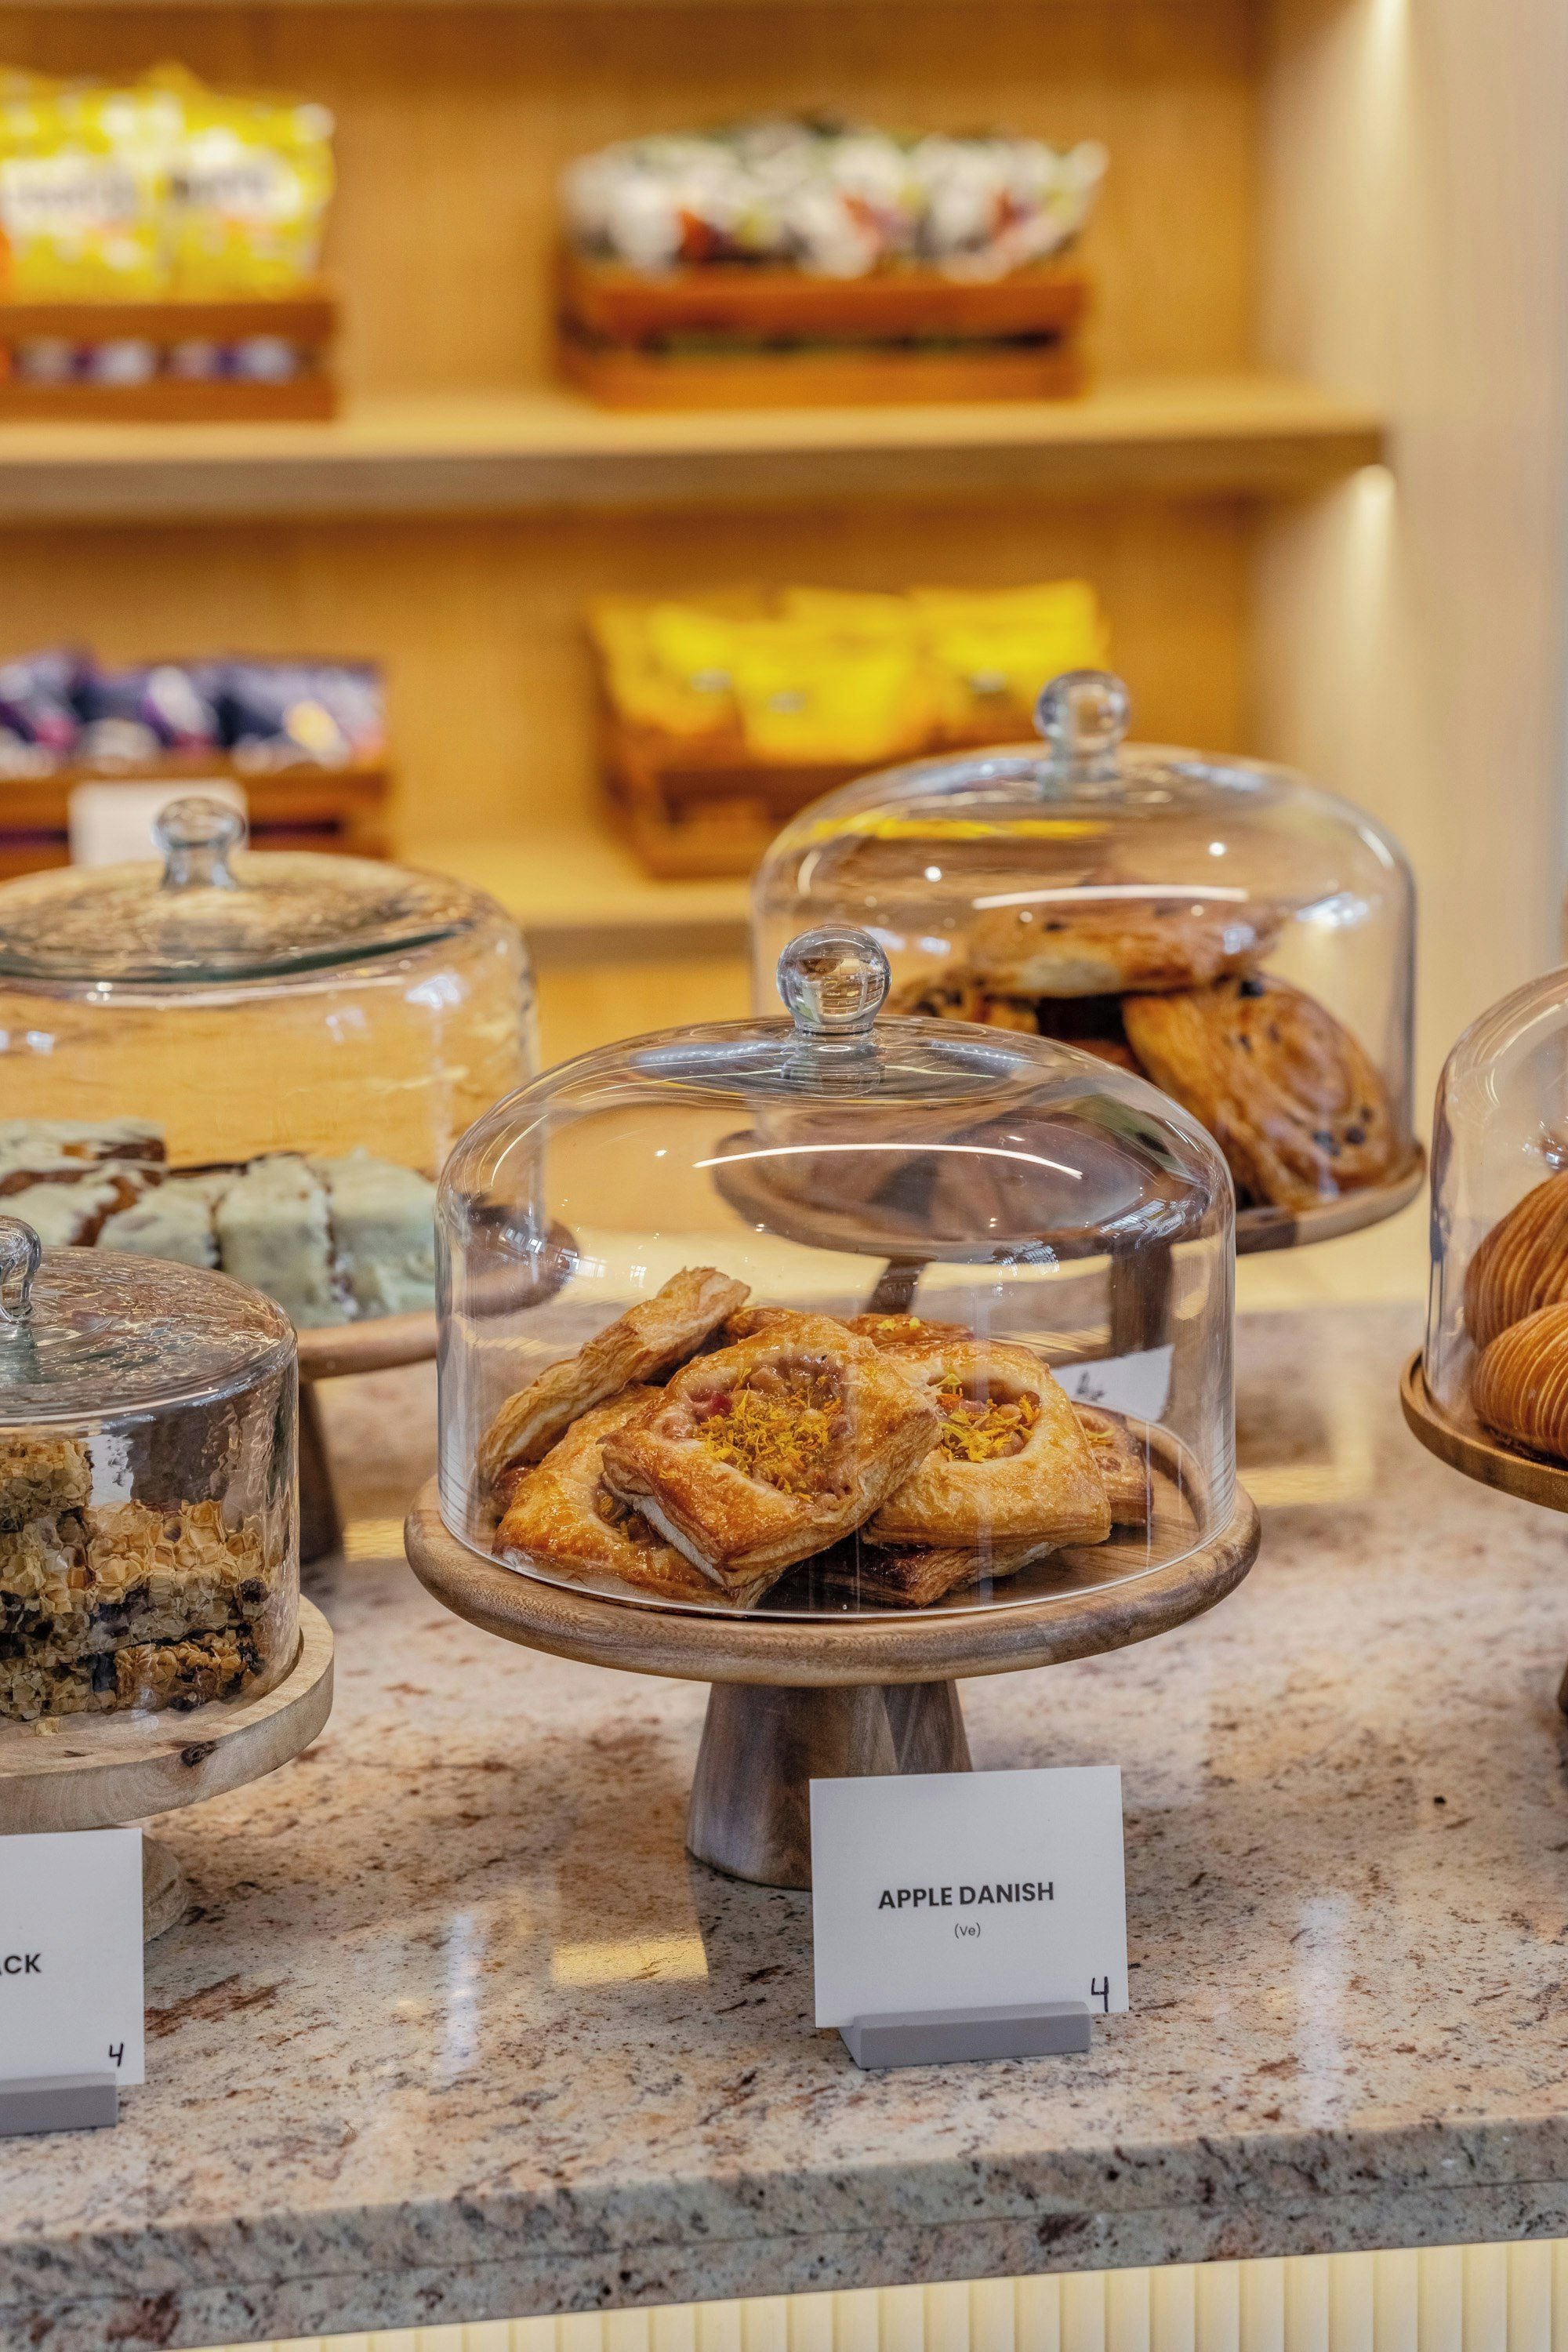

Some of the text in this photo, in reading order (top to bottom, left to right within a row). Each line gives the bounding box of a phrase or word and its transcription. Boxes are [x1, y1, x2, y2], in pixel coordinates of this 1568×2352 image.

[877, 1882, 1054, 1911] APPLE DANISH
[953, 1922, 981, 1940] (Ve)
[0, 1953, 42, 1976] CK
[1091, 1976, 1109, 2013] 4
[108, 2042, 125, 2068] 4
